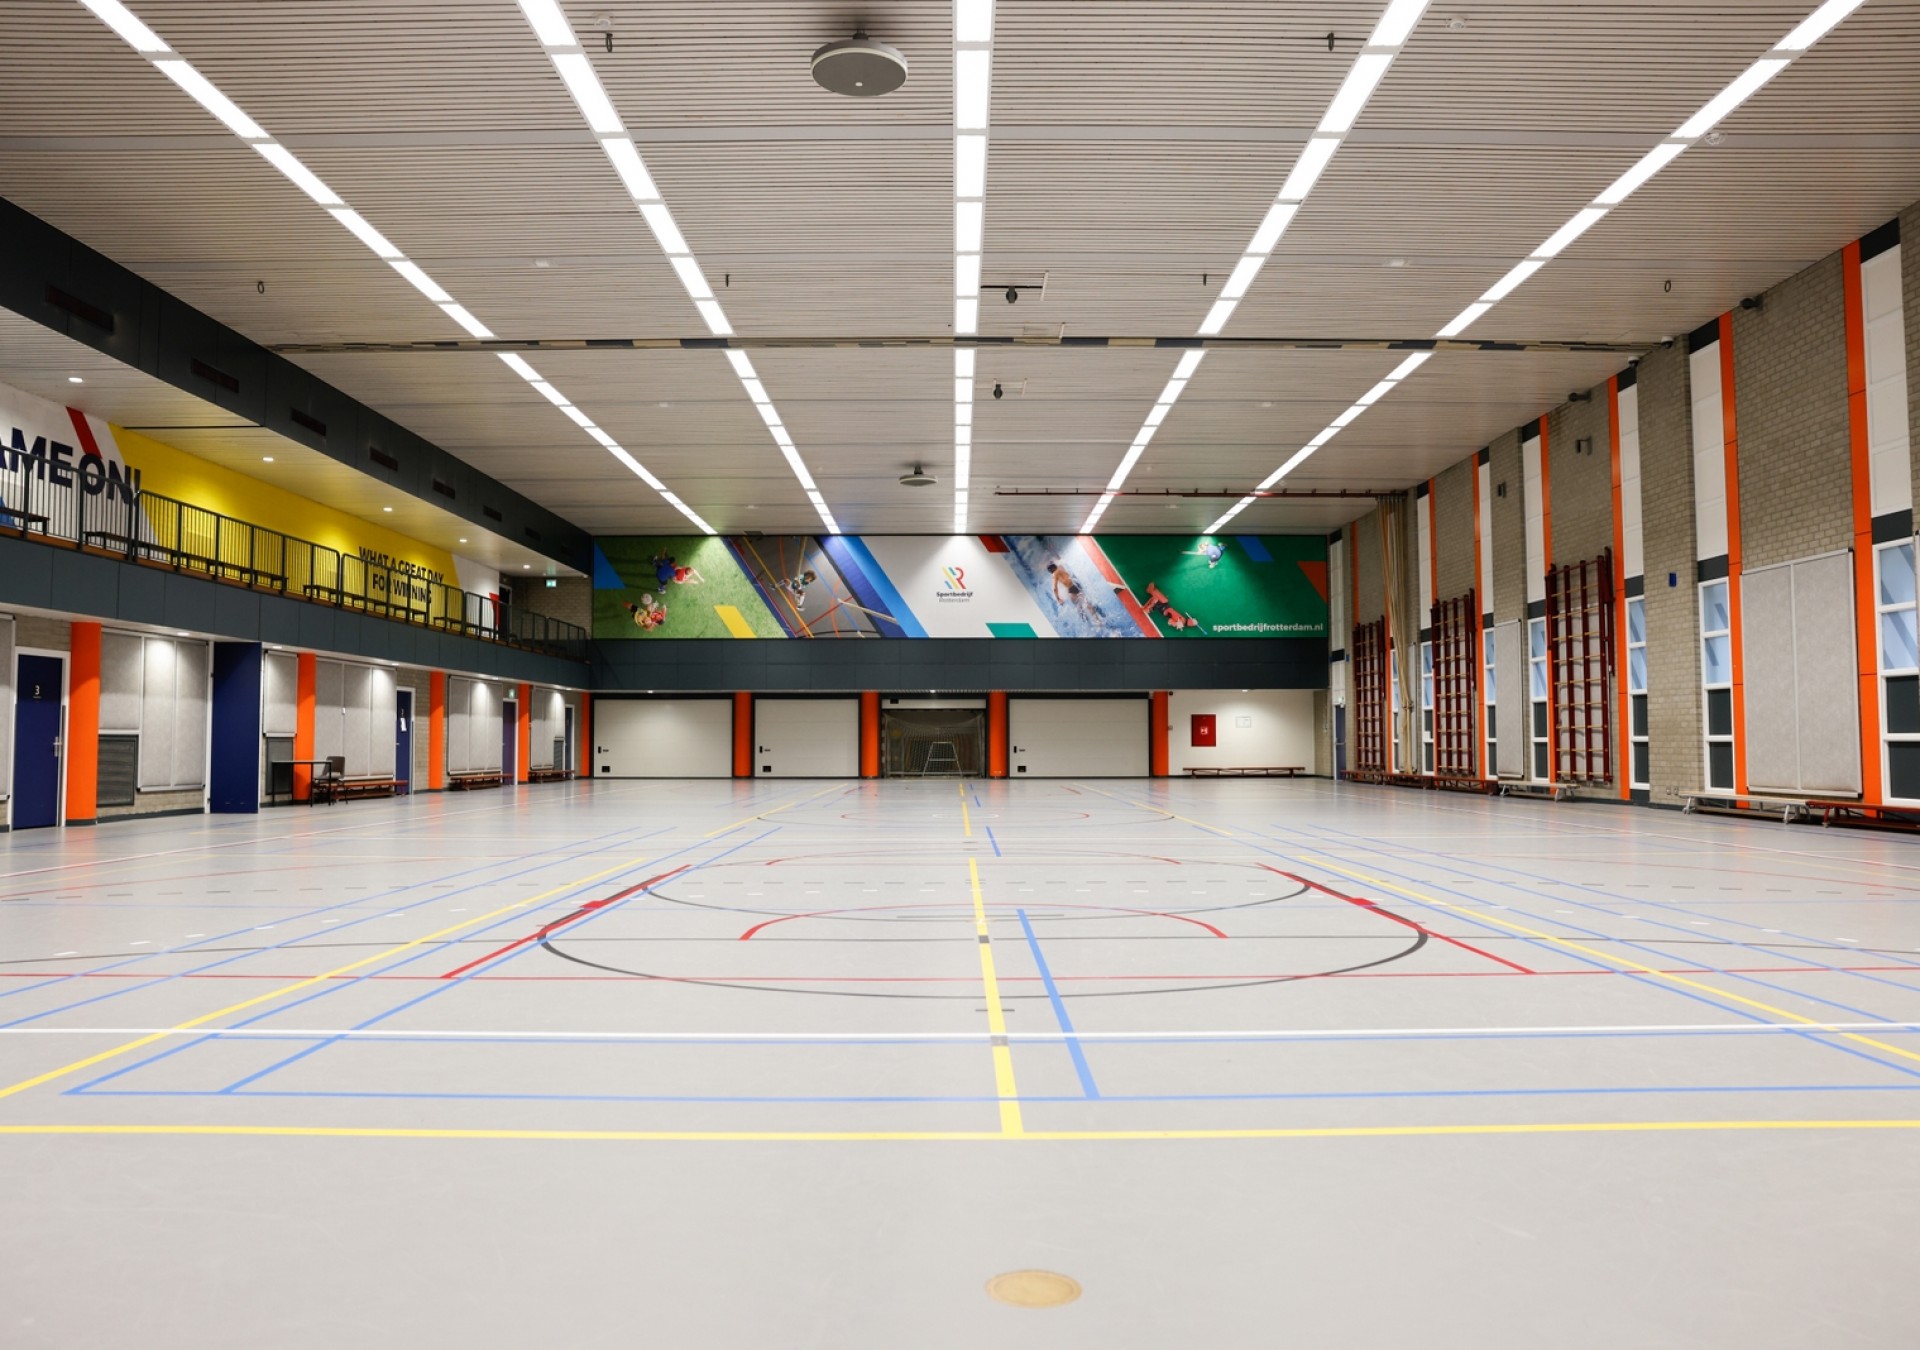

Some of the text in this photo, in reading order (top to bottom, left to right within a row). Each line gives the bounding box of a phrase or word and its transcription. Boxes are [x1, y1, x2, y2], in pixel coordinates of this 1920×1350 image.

[0, 427, 141, 507] ME ON!
[359, 546, 444, 584] WHAT A GREAT DAY
[373, 573, 390, 593] FO
[1212, 623, 1323, 632] sportbedrijfrotterdam.nl
[35, 685, 40, 695] 3
